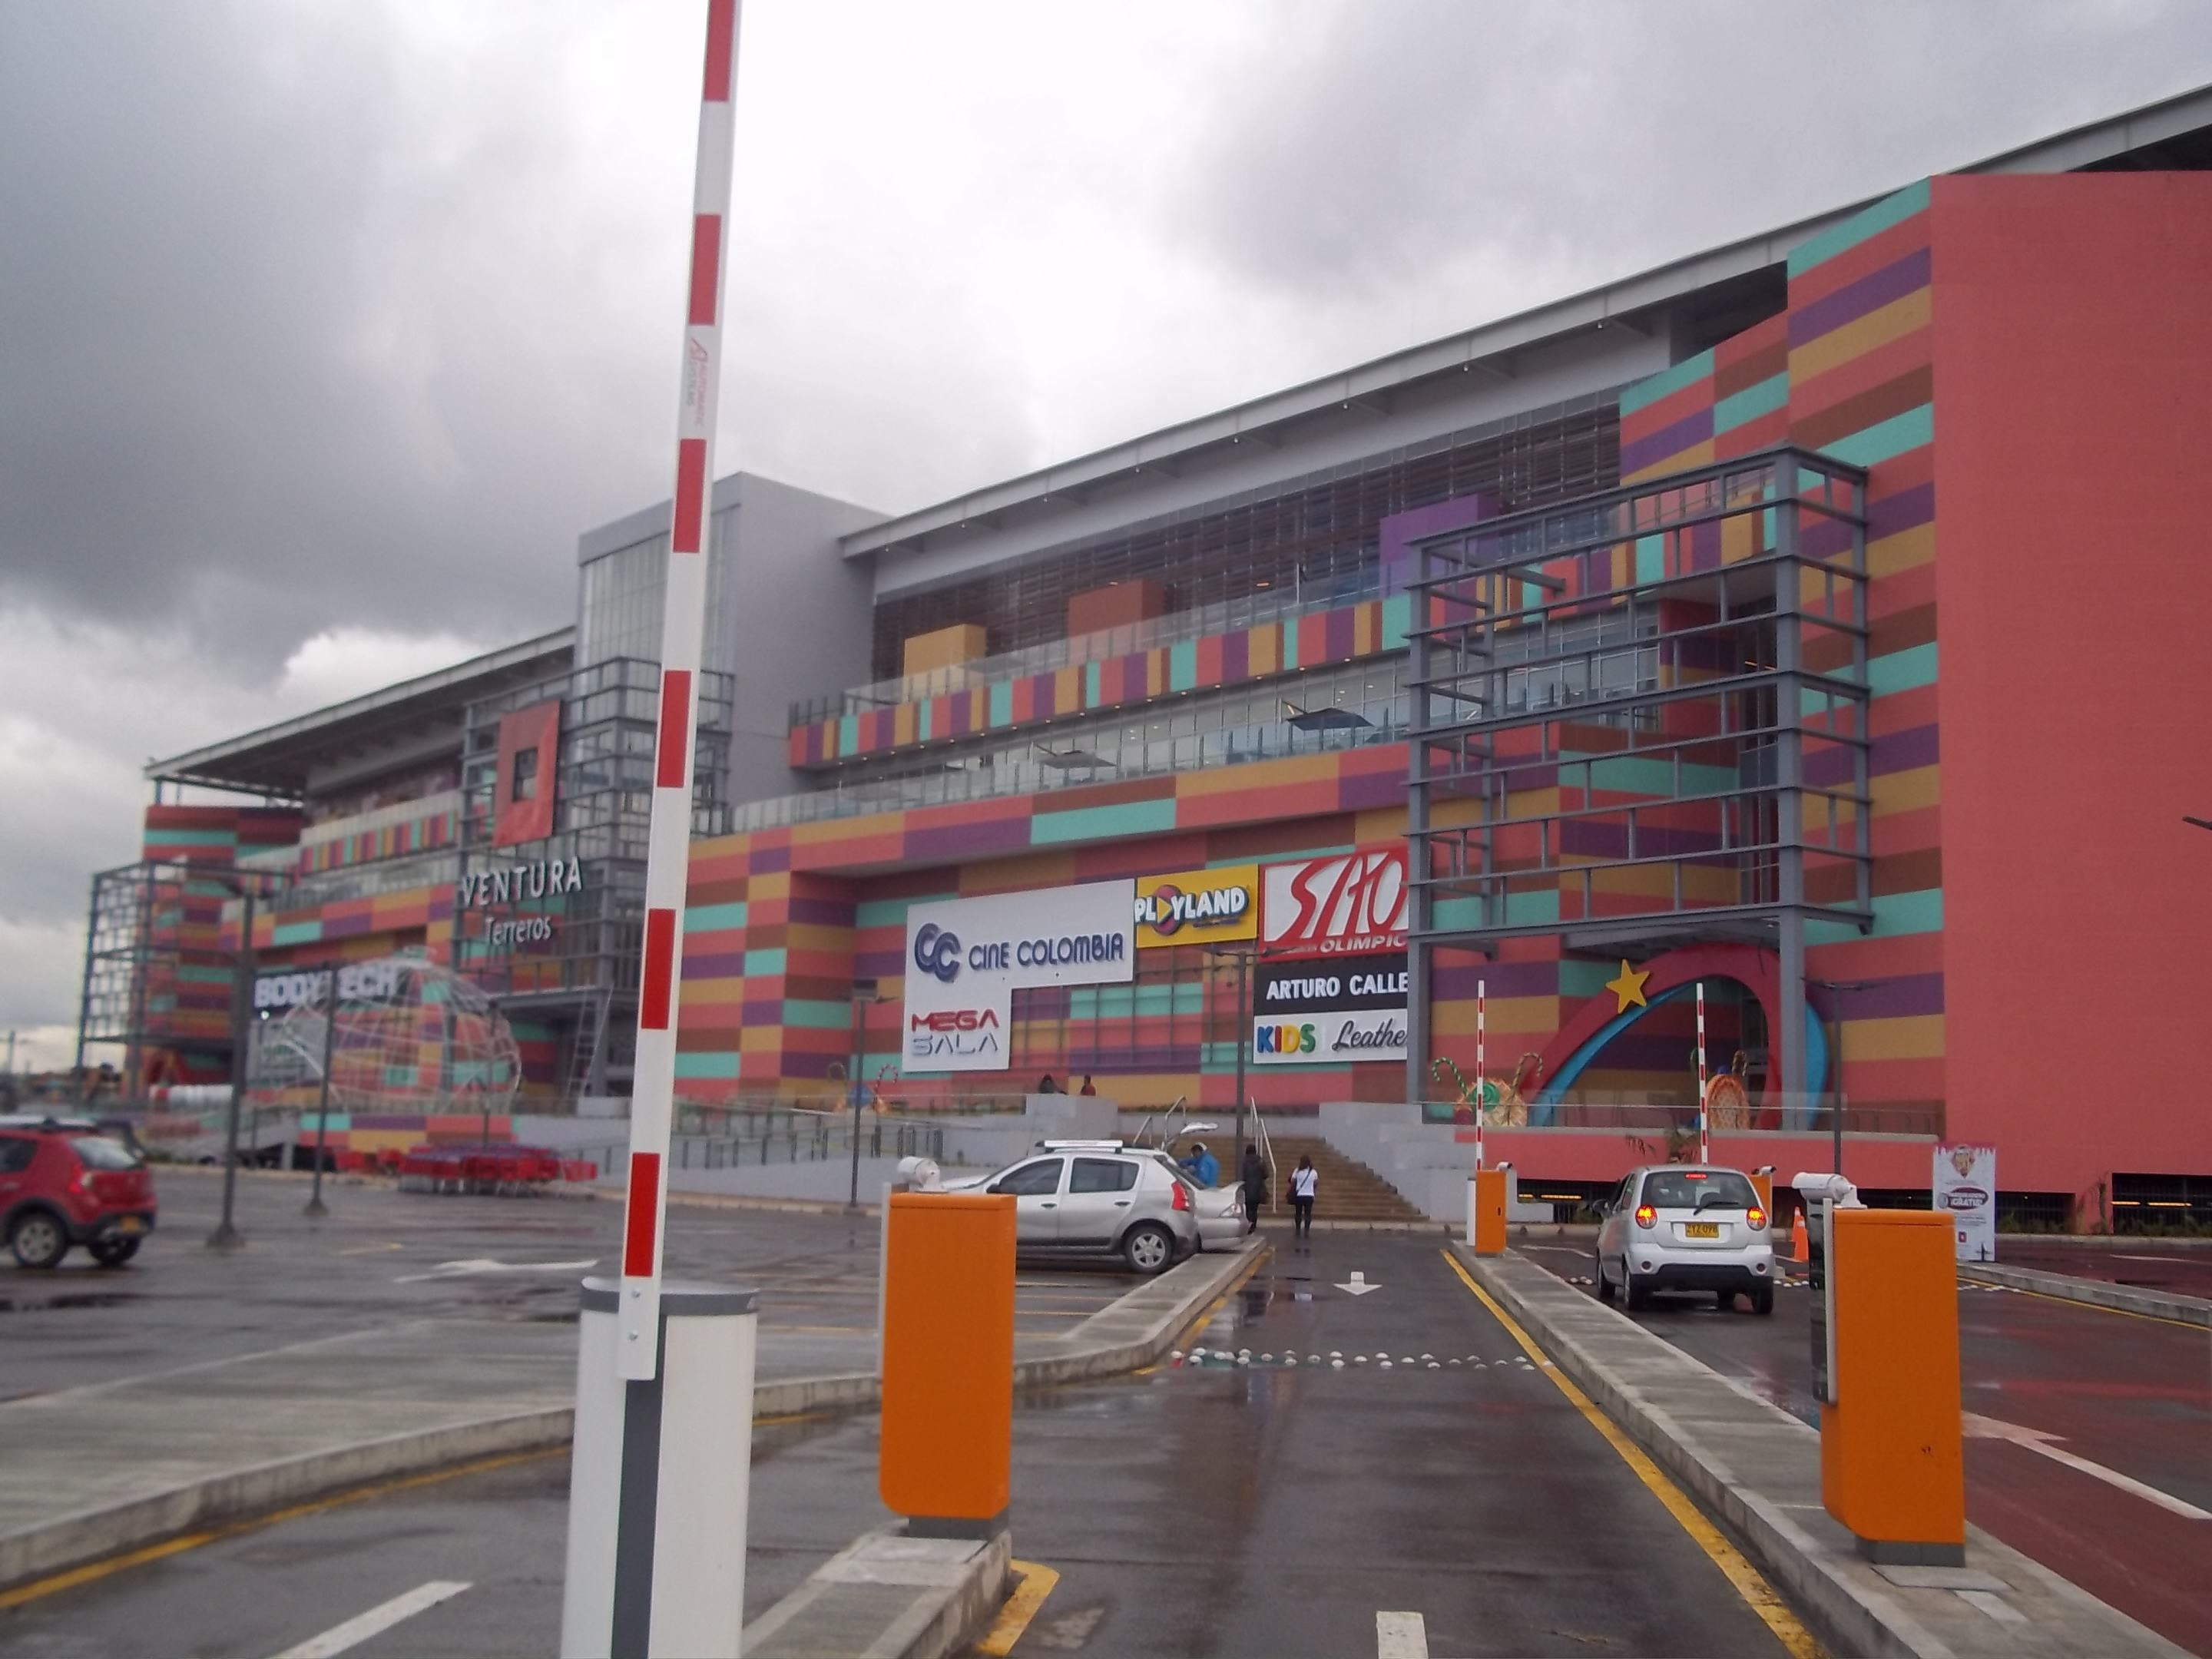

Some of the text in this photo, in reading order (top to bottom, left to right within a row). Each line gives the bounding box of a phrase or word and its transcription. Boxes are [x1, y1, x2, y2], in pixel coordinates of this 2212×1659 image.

[462, 856, 582, 907] VENTURA
[485, 916, 552, 945] Terreros
[1320, 935, 1407, 953] OLIMPIC
[969, 932, 1124, 970] CINE COLOMBIA
[253, 965, 399, 1008] BODYECH
[1267, 972, 1408, 1000] ARTURO CALLE
[911, 1008, 999, 1032] MEGA
[912, 1033, 998, 1056] SALA
[1257, 1017, 1407, 1054] KIDS Leathe
